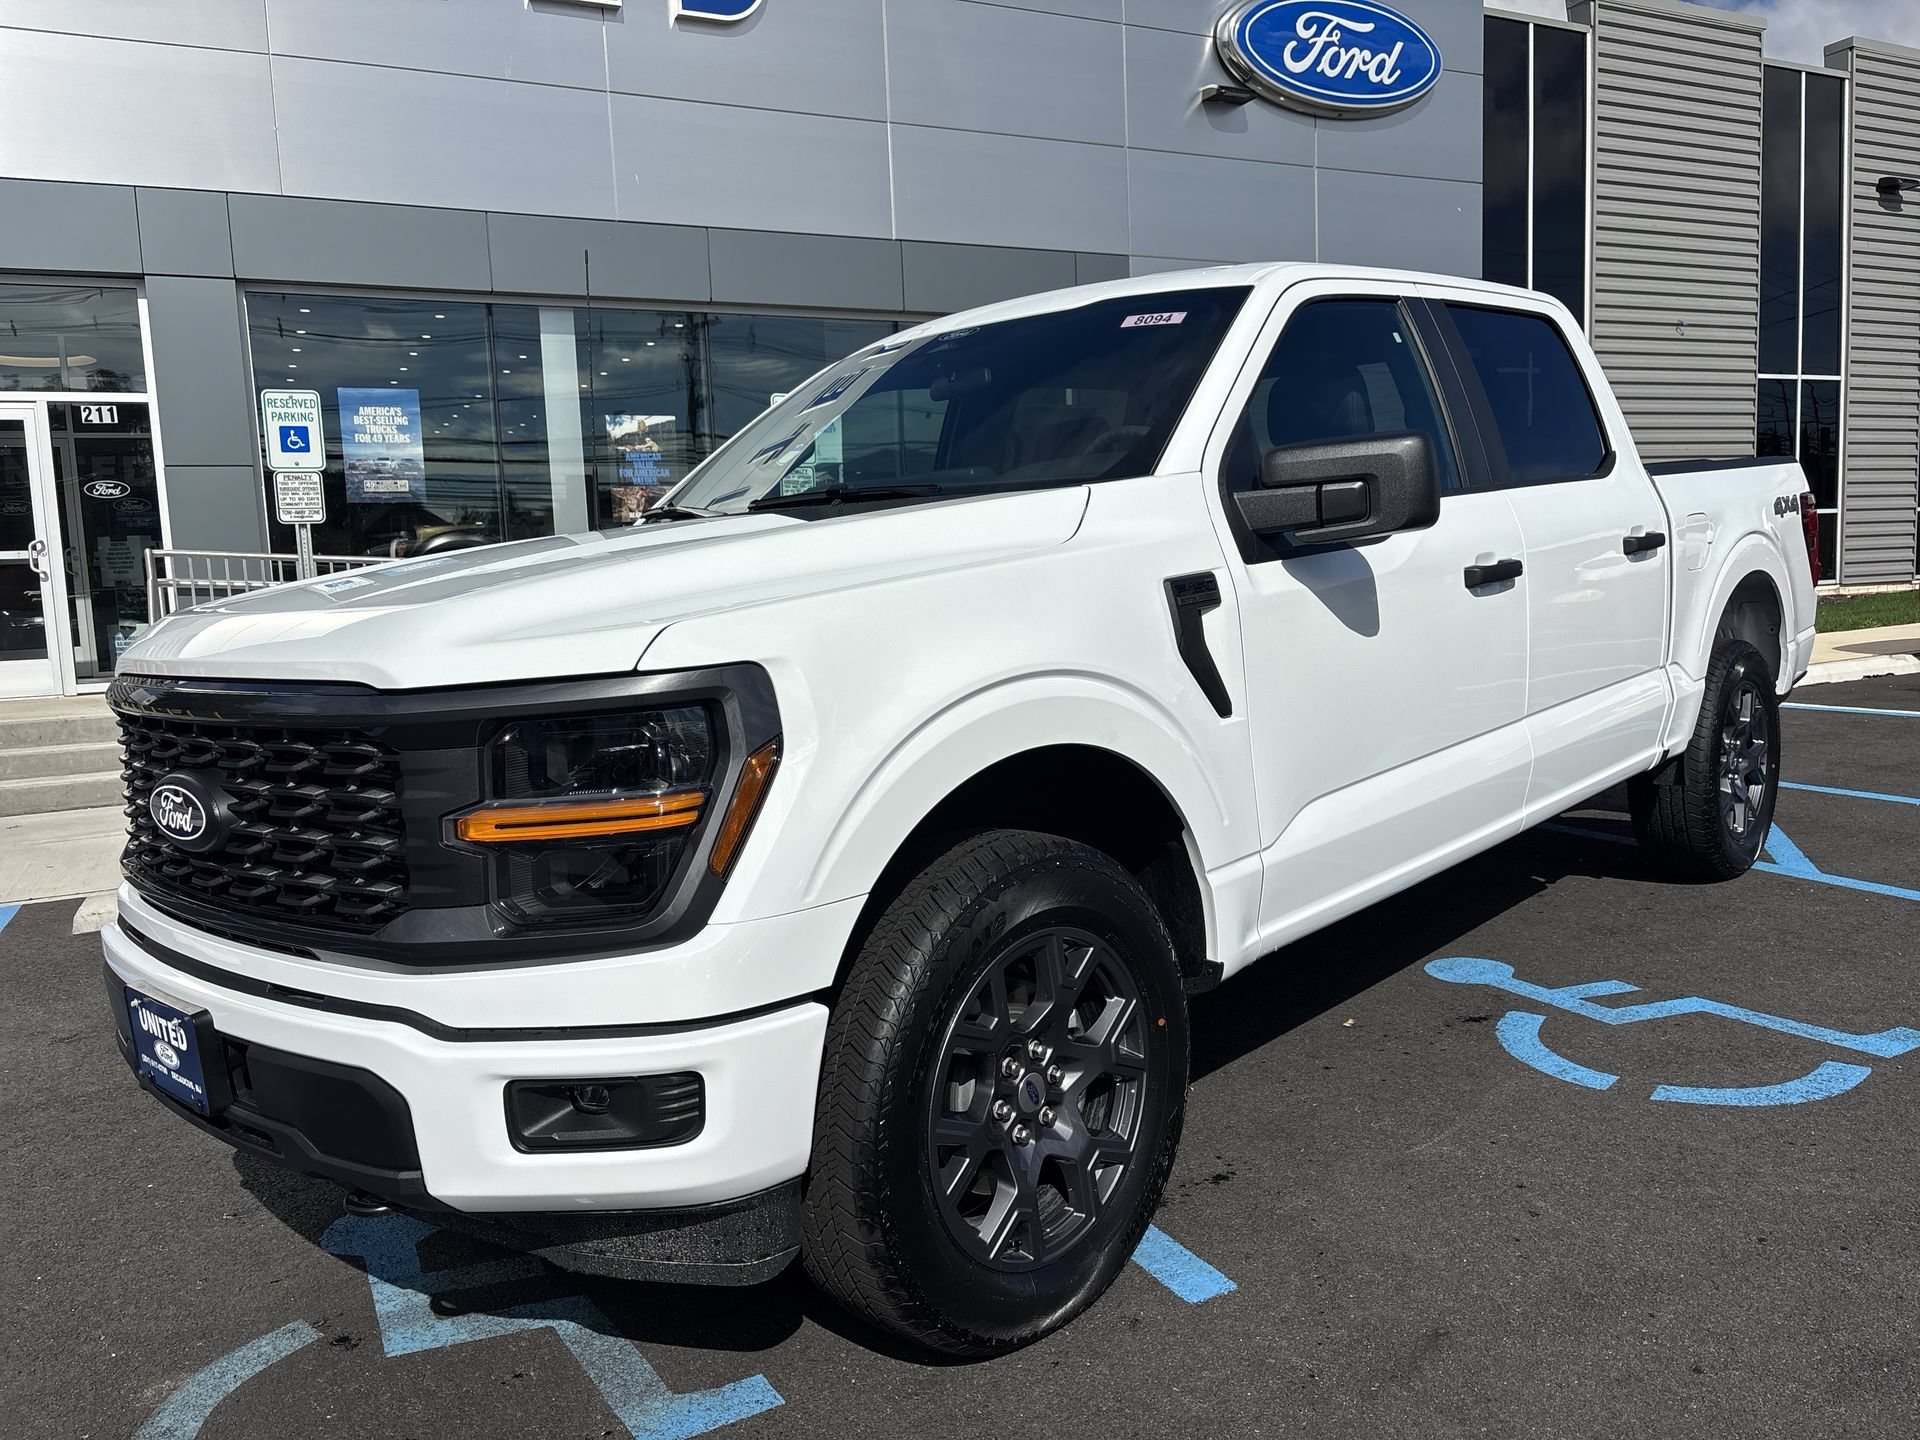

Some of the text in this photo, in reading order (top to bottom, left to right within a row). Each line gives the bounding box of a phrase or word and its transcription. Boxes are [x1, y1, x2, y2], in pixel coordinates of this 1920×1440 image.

[1283, 11, 1404, 85] Ford
[1134, 313, 1173, 325] 8094
[266, 398, 316, 409] RESERVED
[82, 406, 117, 423] 211
[358, 406, 403, 416] AMERICA'S
[271, 412, 314, 423] PARKING
[353, 415, 409, 425] BEST-SELLING
[366, 425, 398, 433] TRUCKS
[354, 433, 411, 443] FOR 49 YEARS
[625, 452, 662, 461] AMERICAN
[619, 468, 670, 477] FOR AMERICAN
[93, 483, 122, 496] Ford
[159, 790, 194, 833] Ford
[138, 1006, 188, 1052] UNITED
